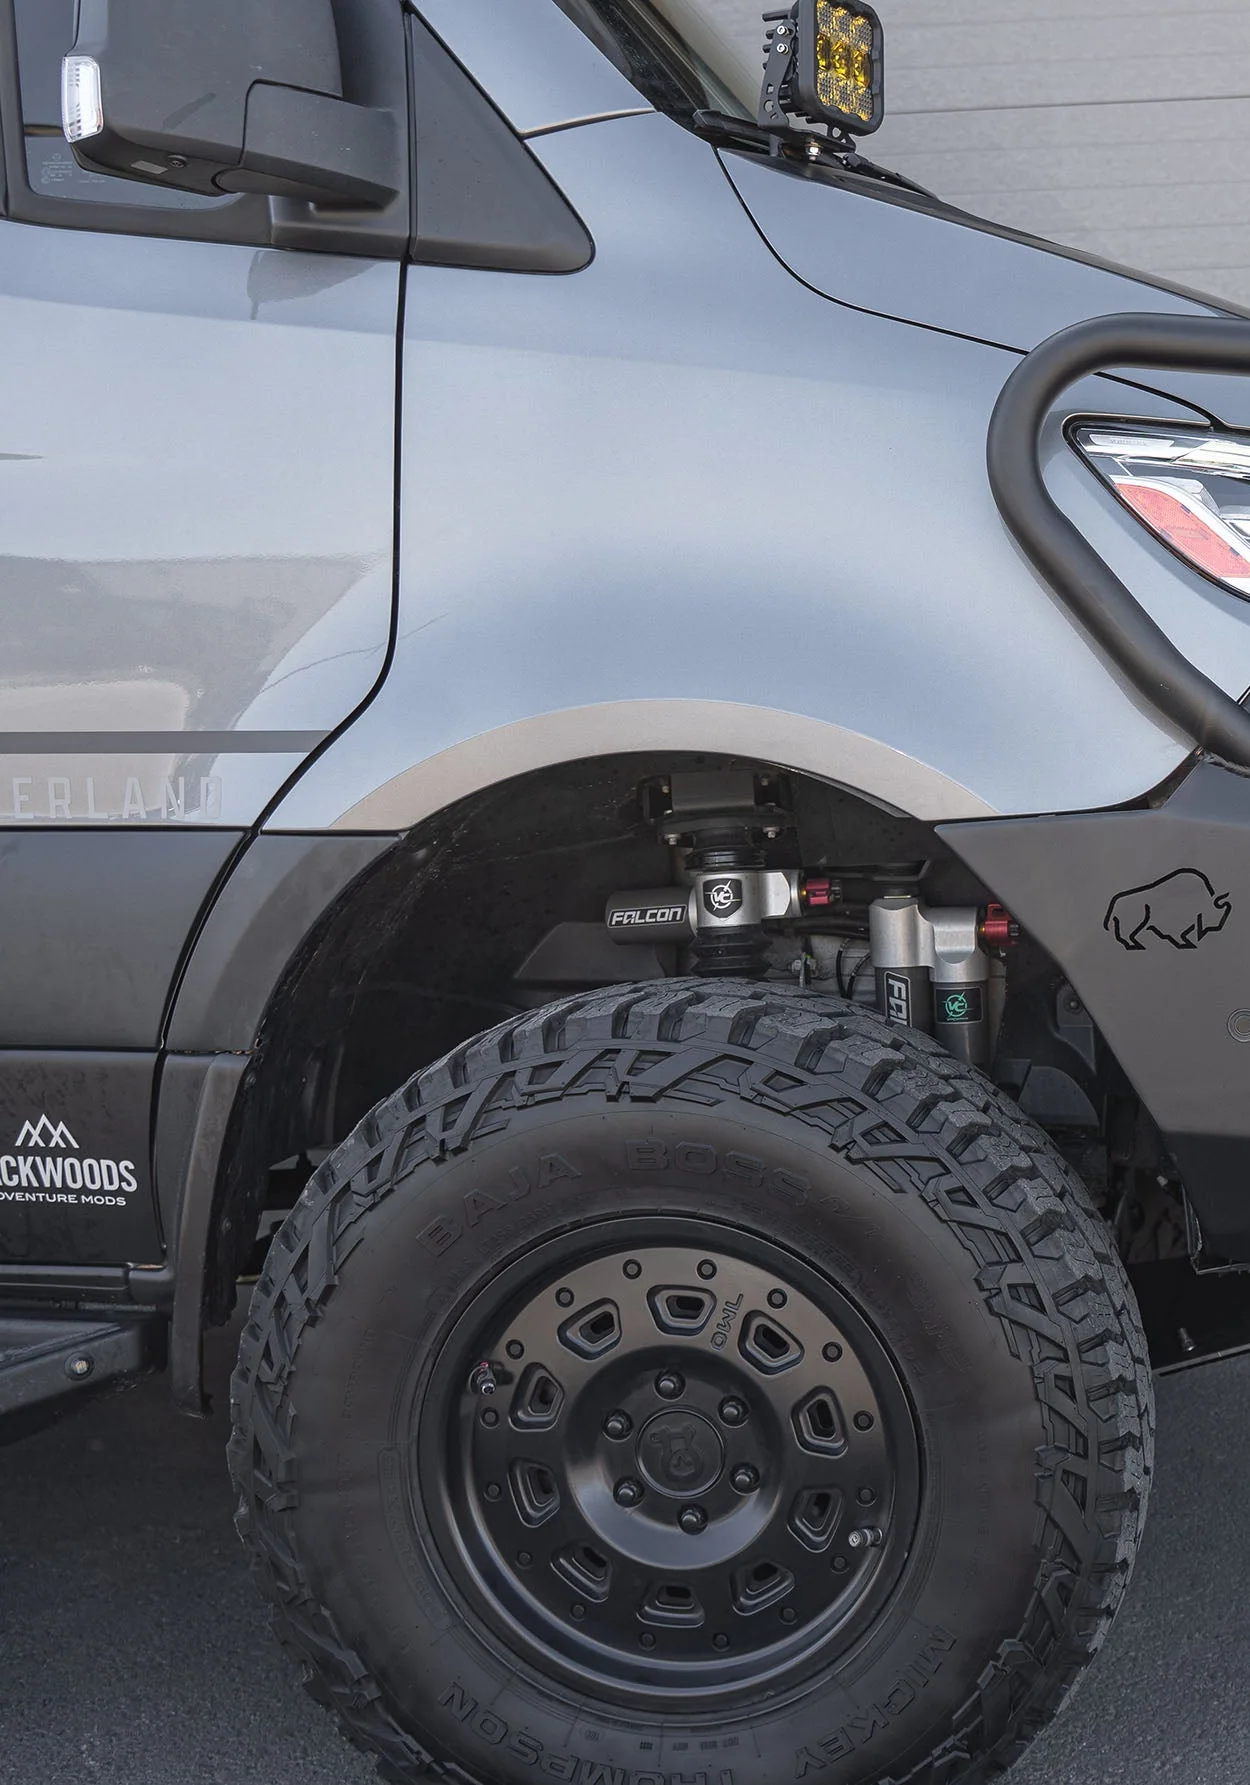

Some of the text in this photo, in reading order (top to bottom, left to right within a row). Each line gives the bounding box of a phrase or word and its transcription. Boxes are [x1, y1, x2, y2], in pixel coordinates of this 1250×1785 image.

[12, 776, 223, 820] ERLAND
[611, 907, 682, 926] FALCON
[0, 1155, 138, 1192] CKWOODS
[81, 1195, 127, 1206] MODS
[415, 1149, 584, 1257] BAJA
[624, 1138, 813, 1208] BOSS
[710, 1293, 744, 1352] OWL
[793, 1623, 958, 1779] MICKEY
